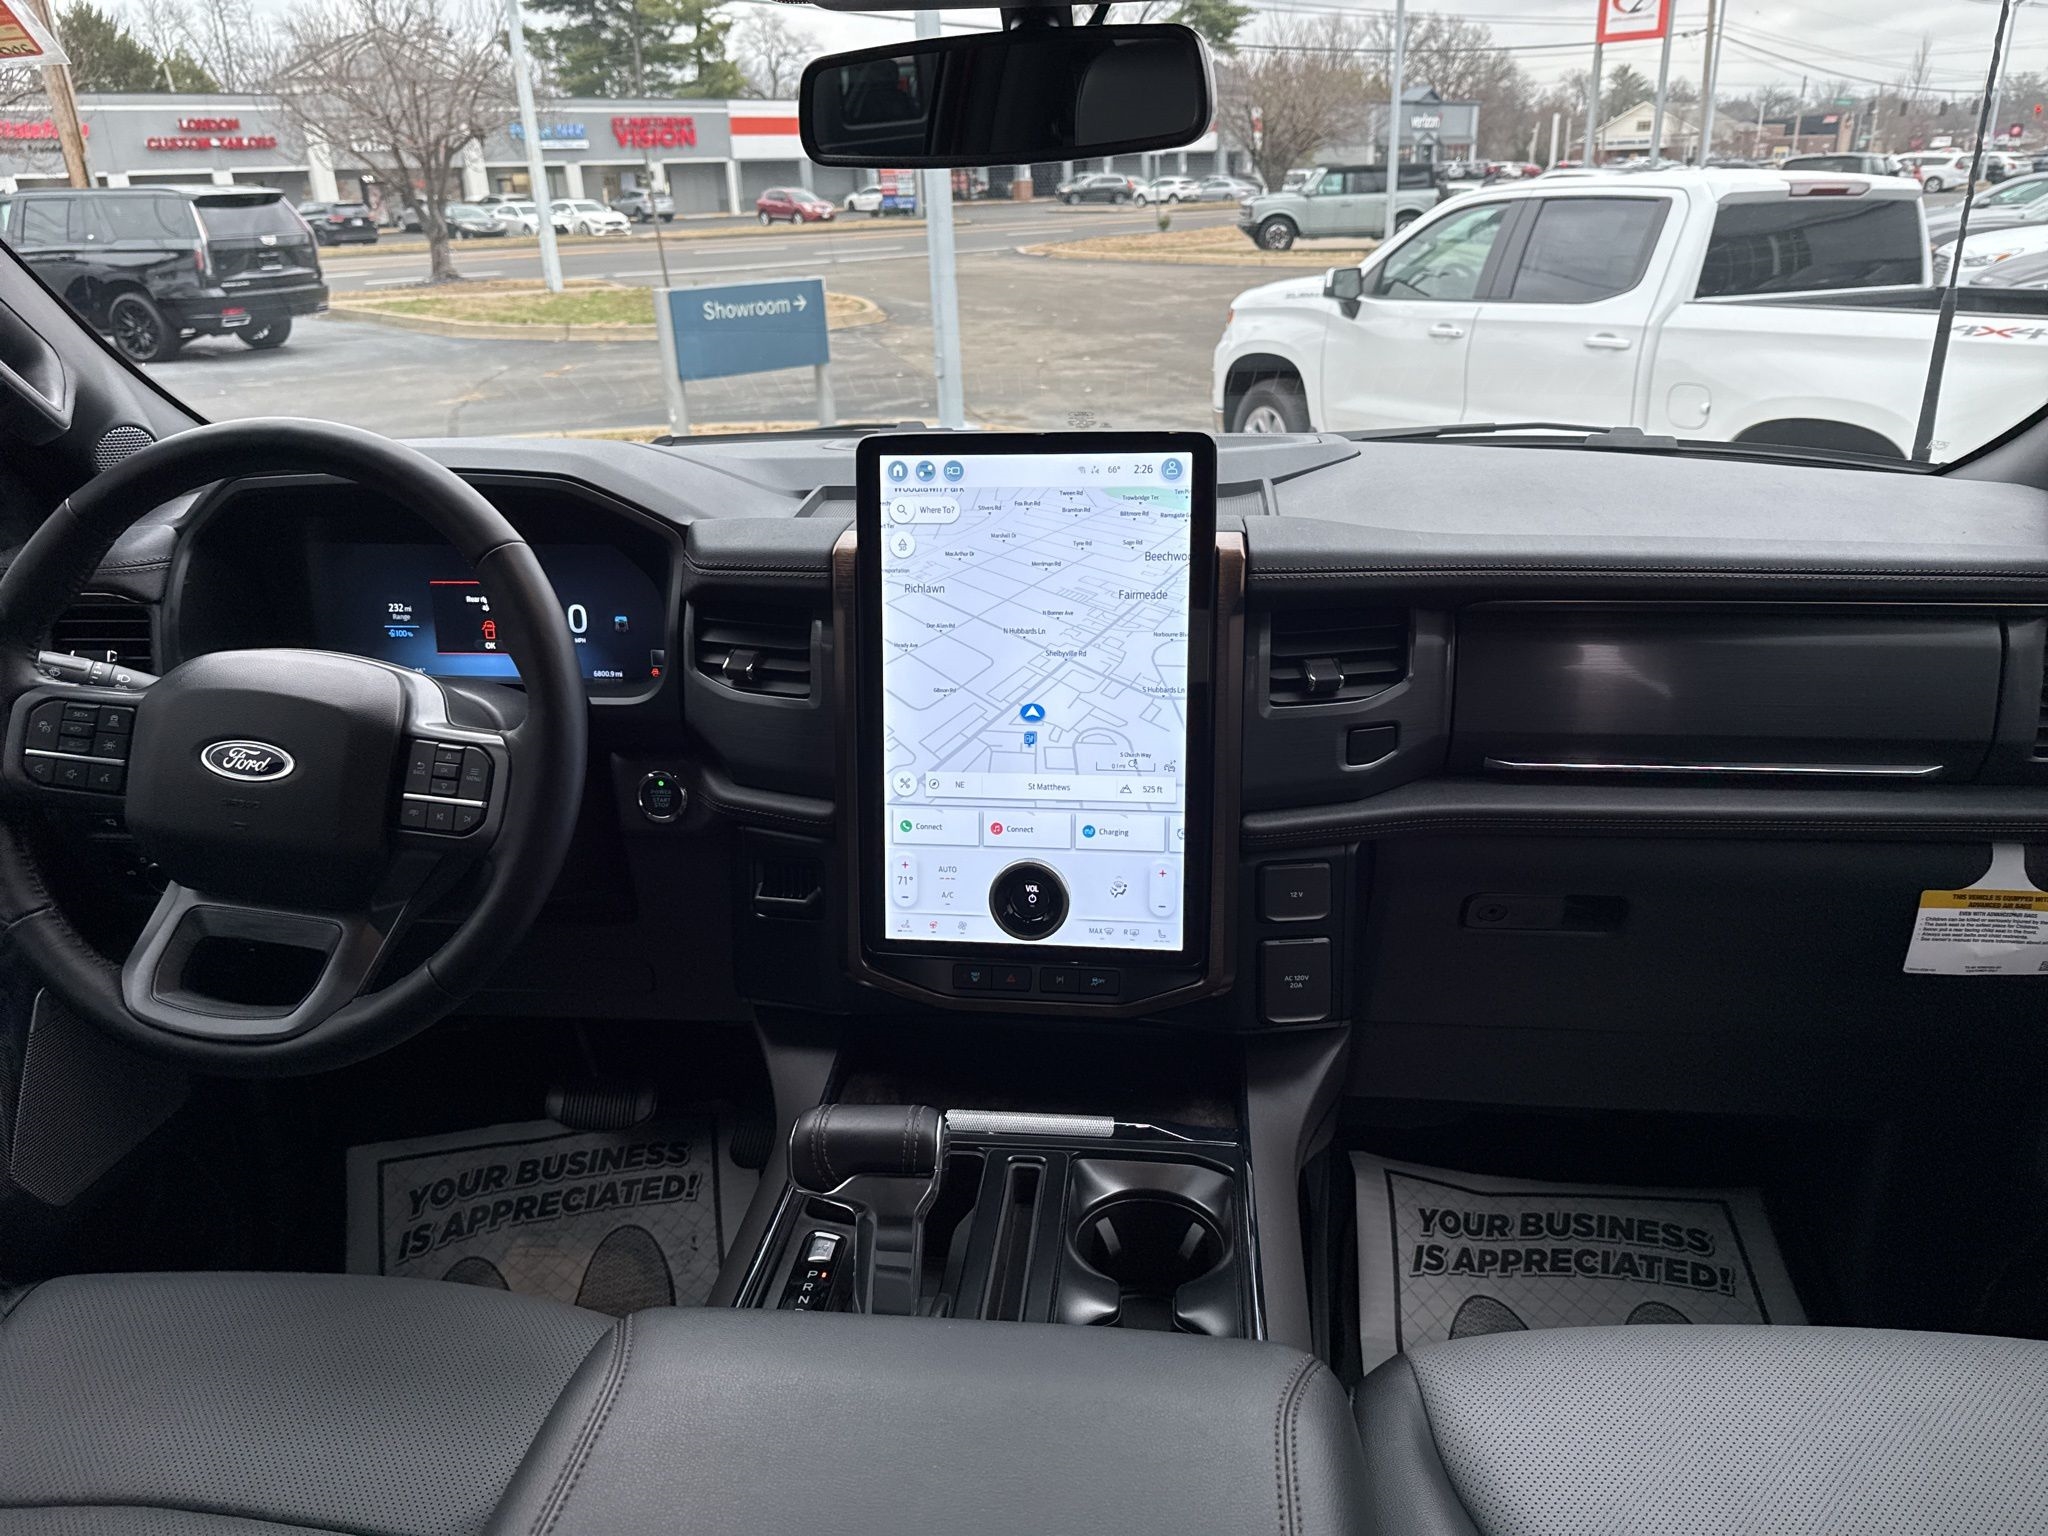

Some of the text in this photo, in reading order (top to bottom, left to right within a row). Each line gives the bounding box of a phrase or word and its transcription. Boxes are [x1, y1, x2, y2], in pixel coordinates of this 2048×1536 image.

[612, 127, 698, 150] VISION
[702, 298, 791, 321] Showroom
[1107, 465, 1121, 474] 66°
[1133, 464, 1154, 474] 2:26
[919, 506, 955, 514] Where To?
[904, 583, 945, 594] Richlawn
[1118, 589, 1168, 600] Fairmeade
[388, 603, 404, 613] 232
[392, 613, 411, 622] Range
[567, 603, 588, 634] 0
[1009, 627, 1038, 635] Hubbards
[484, 642, 496, 650] OK
[1045, 649, 1078, 658] Shelbyville
[593, 670, 624, 678] 6800.9 mi
[1147, 686, 1177, 694] Hubbards
[222, 747, 272, 773] Ford
[1036, 783, 1071, 792] Matthews
[1142, 785, 1156, 793] 525
[915, 822, 943, 831] Connect
[1006, 825, 1034, 834] Connect
[1099, 828, 1129, 837] Charging
[938, 865, 957, 873] AUTO
[897, 875, 914, 886] 71°
[1024, 884, 1040, 893] VOL
[941, 891, 955, 899] A/C
[407, 1140, 693, 1218] YOUR BUSINESS
[398, 1173, 700, 1262] IS APPRECIATED!
[1417, 1207, 1714, 1254] YOUR BUSINESS
[1412, 1243, 1733, 1293] IS APPRECIATED!
[806, 1270, 818, 1279] P
[802, 1282, 814, 1291] R
[797, 1295, 810, 1304] N
